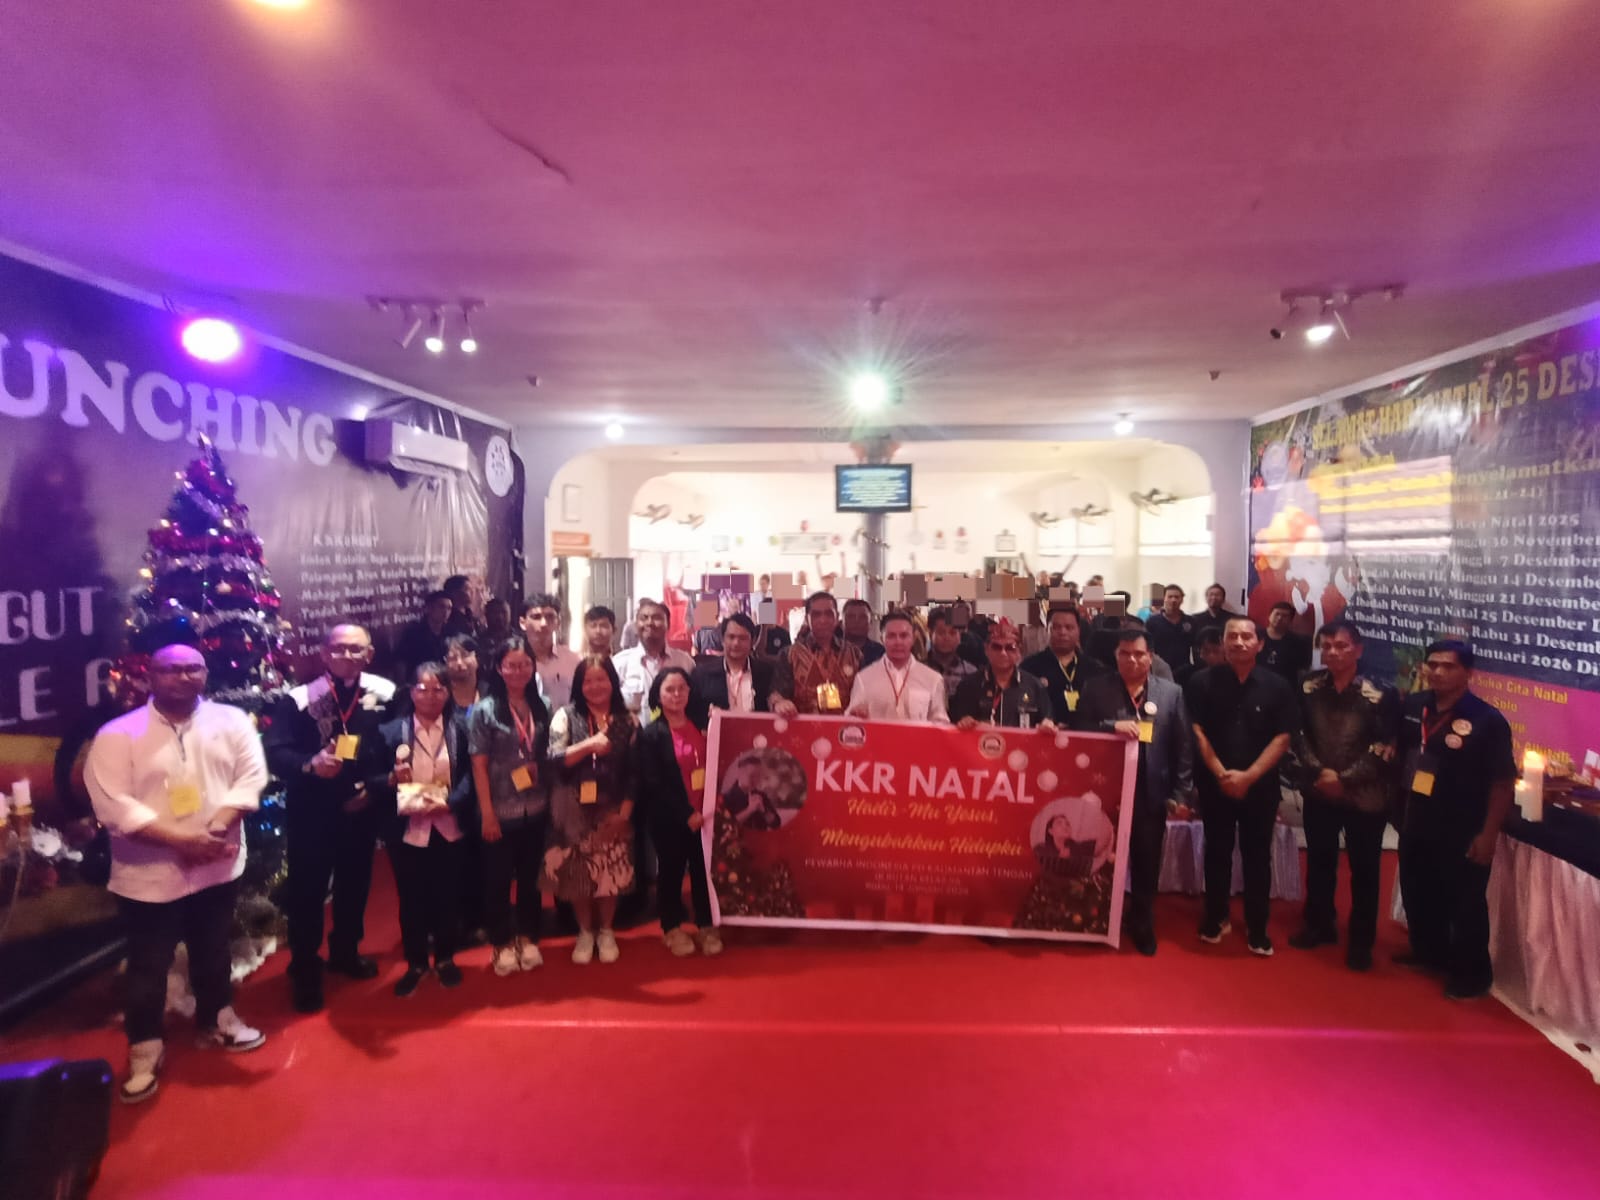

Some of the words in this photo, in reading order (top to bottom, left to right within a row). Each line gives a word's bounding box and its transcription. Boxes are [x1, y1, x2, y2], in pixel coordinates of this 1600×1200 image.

[1501, 367, 1529, 409] 25
[1537, 350, 1600, 400] DES
[1491, 514, 1533, 529] Natal
[1538, 513, 1580, 527] 2025
[1500, 556, 1509, 567] 7
[1393, 568, 1426, 580] Adven
[1449, 570, 1498, 586] Minggu
[1391, 584, 1426, 597] Adven
[1448, 588, 1495, 604] Minggu
[1499, 592, 1516, 605] 21
[1390, 599, 1441, 616] Perayaan
[1444, 605, 1478, 620] Natal
[1481, 610, 1498, 623] 25
[1502, 609, 1587, 632] Desember
[1390, 615, 1424, 631] Tutup
[1426, 619, 1470, 638] Tahun,
[1472, 625, 1509, 642] Rabu
[1512, 632, 1531, 646] 31
[1389, 630, 1424, 647] Tahun
[1531, 654, 1573, 672] 2026
[1533, 685, 1569, 705] Natal
[815, 758, 897, 796] KKR
[908, 764, 1035, 804] NATAL
[820, 828, 946, 852] Mengubahkan
